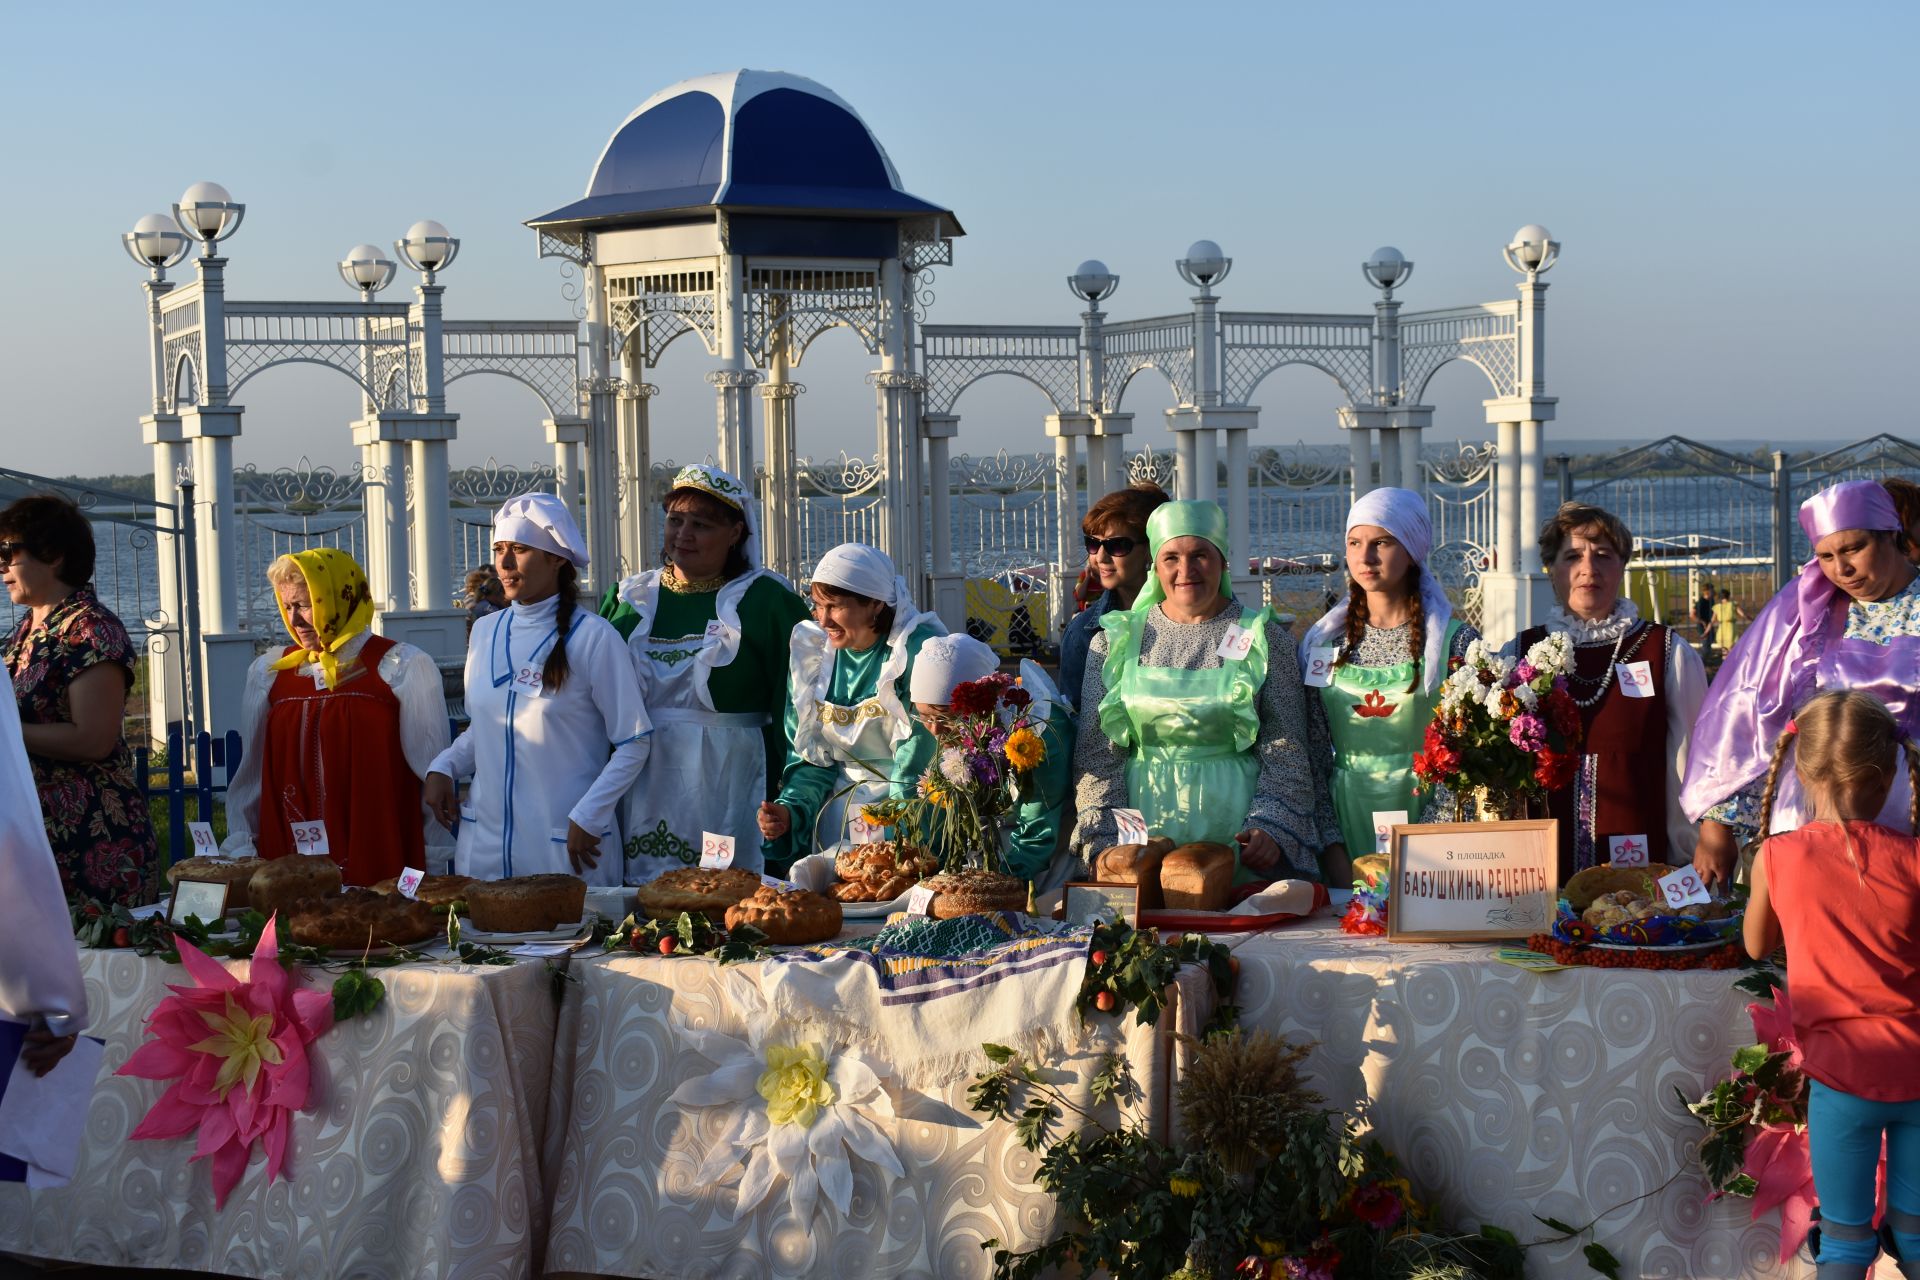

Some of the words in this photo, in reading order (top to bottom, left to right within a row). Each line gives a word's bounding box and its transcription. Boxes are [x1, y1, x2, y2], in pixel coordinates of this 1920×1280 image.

[1226, 634, 1250, 651] 13
[517, 668, 541, 687] 22
[1622, 668, 1648, 686] 25
[194, 830, 212, 846] 31
[295, 827, 321, 842] 23
[705, 840, 729, 858] 28
[1446, 851, 1453, 860] 3
[1614, 843, 1644, 863] 25
[1404, 869, 1484, 900] БАБУШКИНЫ
[1488, 867, 1547, 904] РЕЦЕПТЫ
[1667, 876, 1700, 902] 32
[910, 895, 926, 913] 29
